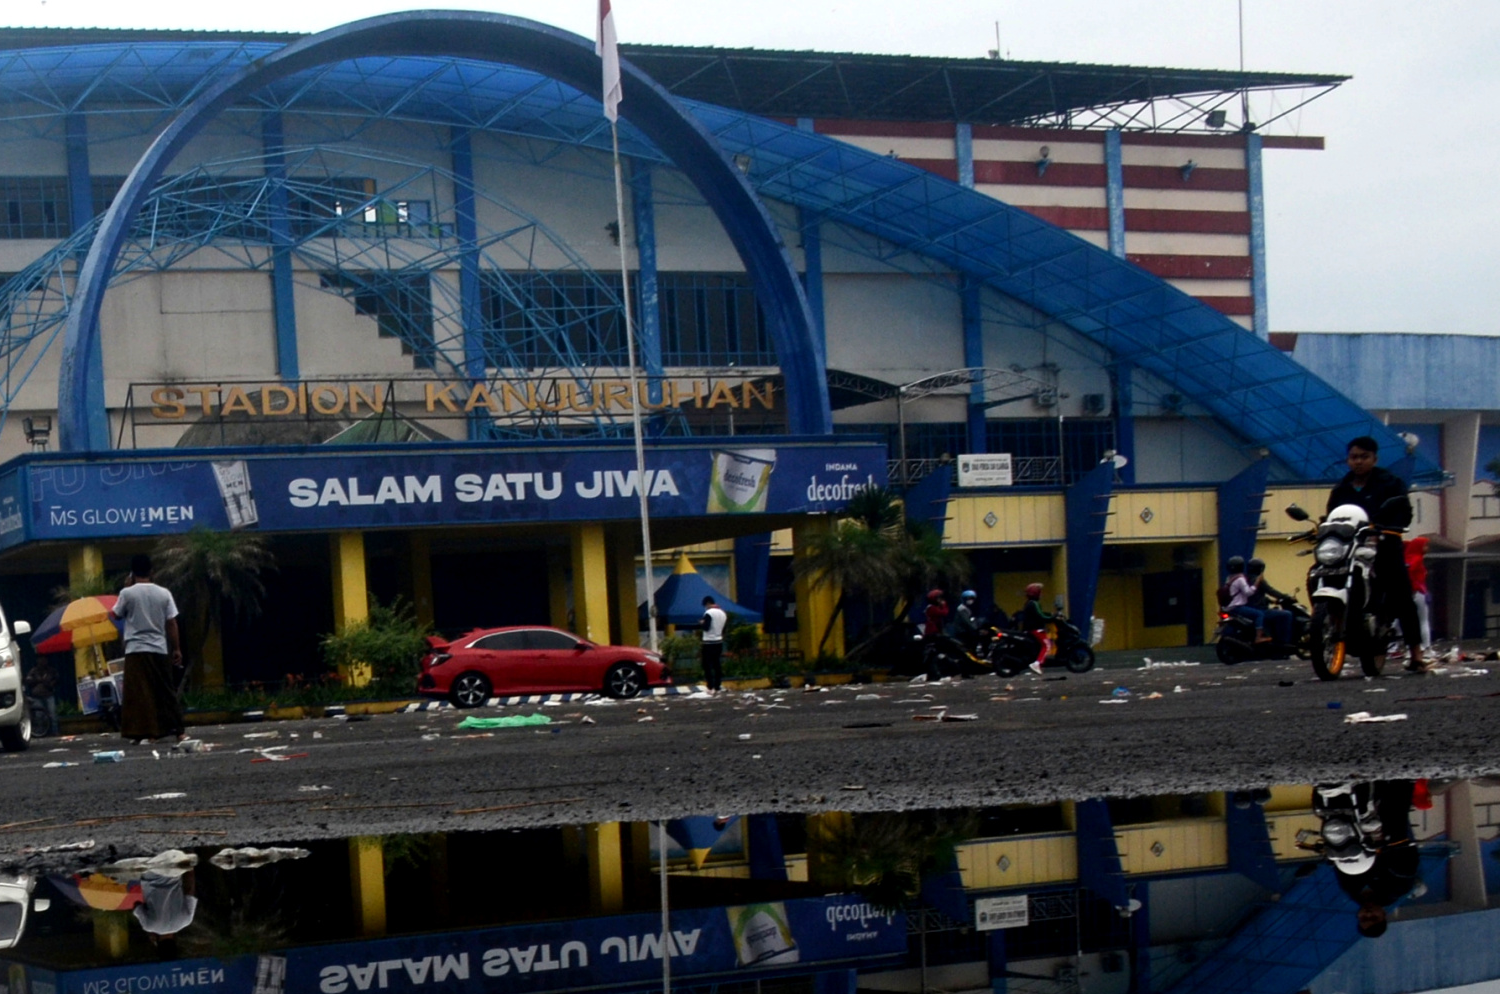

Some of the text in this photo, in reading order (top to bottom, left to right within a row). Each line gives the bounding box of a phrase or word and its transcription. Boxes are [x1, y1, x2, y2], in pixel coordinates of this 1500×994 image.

[150, 380, 774, 419] STADION KANJURUHAN
[826, 463, 857, 471] INDANA
[288, 470, 679, 507] SALAM SATU JIWA
[51, 507, 77, 526] MS
[82, 508, 137, 525] GLOW
[149, 506, 194, 522] MEN
